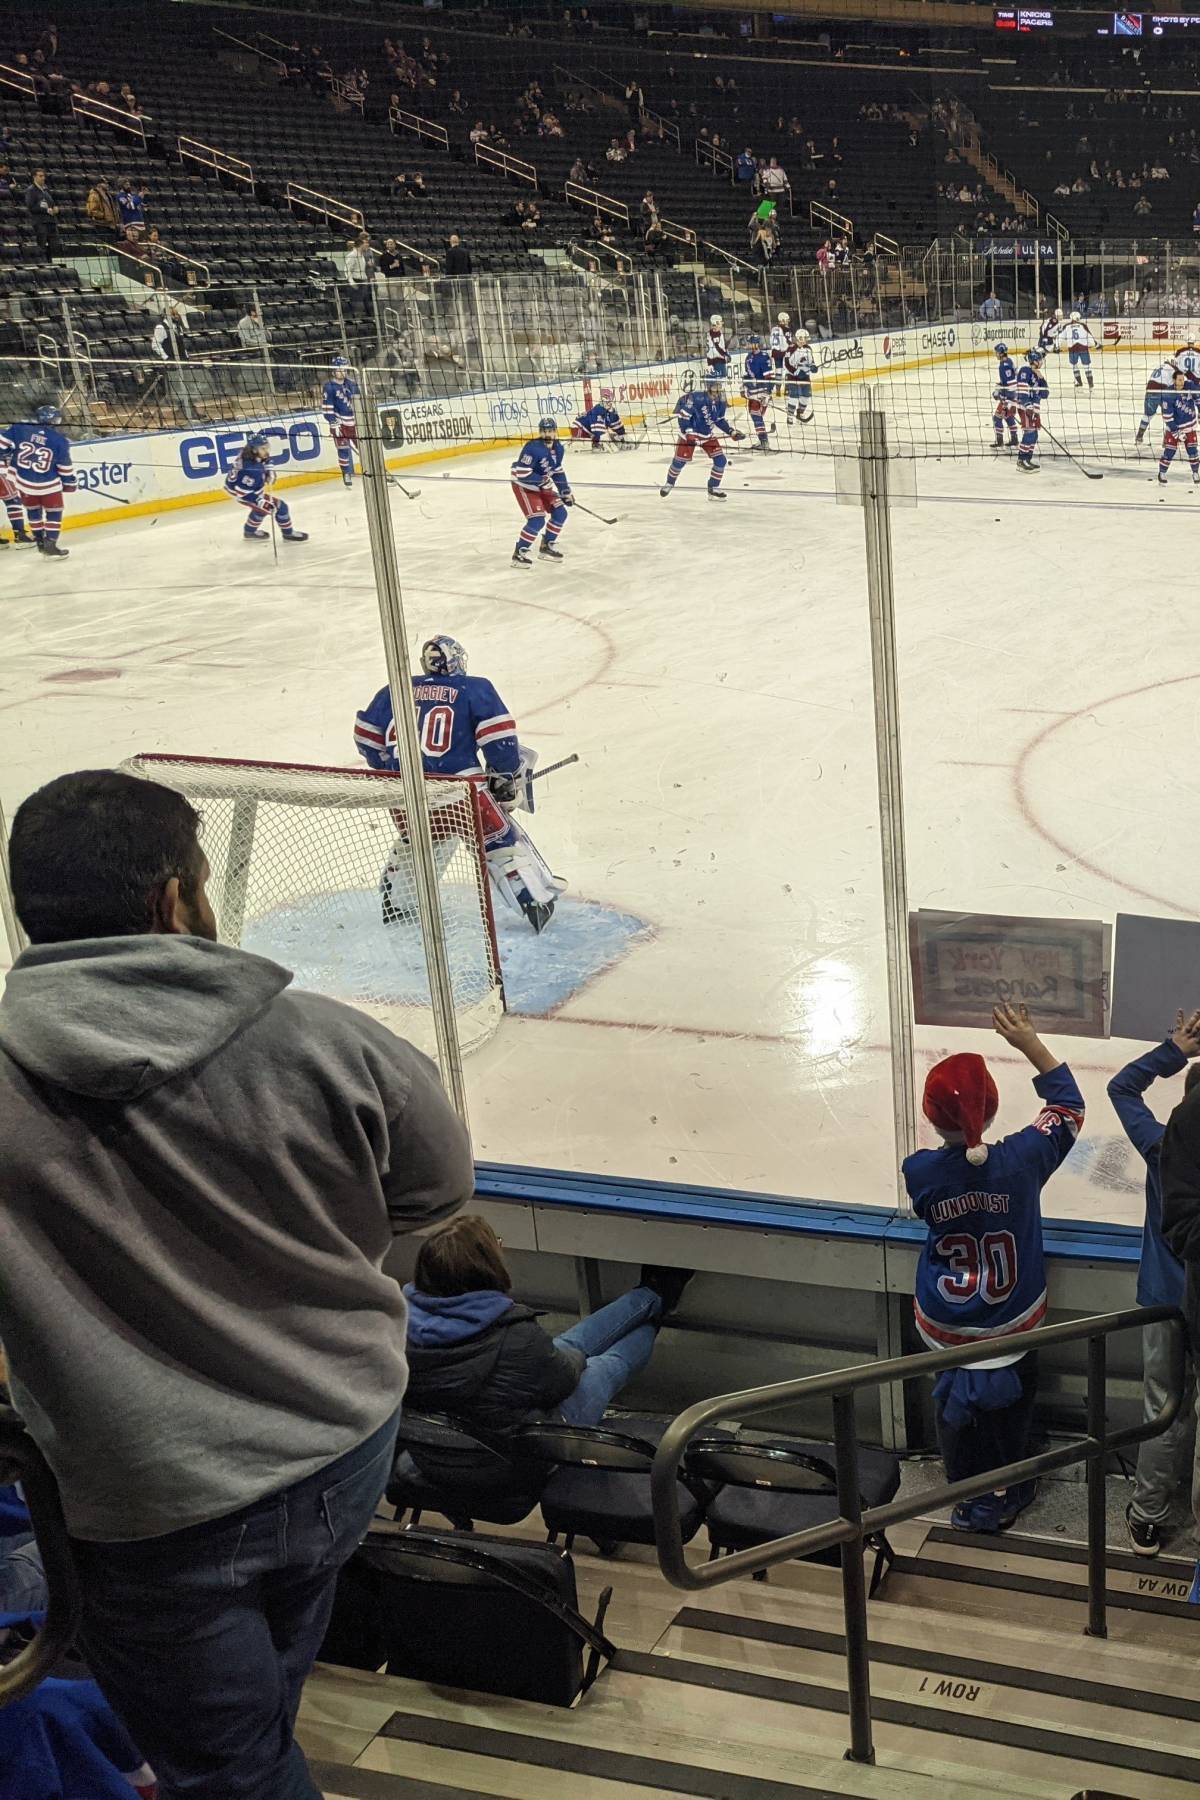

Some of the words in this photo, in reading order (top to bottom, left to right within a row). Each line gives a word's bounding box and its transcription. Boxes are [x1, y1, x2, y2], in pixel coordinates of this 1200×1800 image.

[1021, 245, 1054, 255] ULRA
[921, 330, 947, 350] CHASE
[403, 403, 444, 421] CAESARS
[404, 415, 474, 445] SPORTSBOOK
[16, 441, 54, 473] 23
[179, 422, 321, 479] GECO
[931, 1191, 1009, 1224] LUNDQVIST
[936, 1230, 1018, 1305] 30
[1137, 1577, 1158, 1592] AA
[1162, 1581, 1188, 1598] OW
[918, 1676, 928, 1692] 1
[934, 1680, 981, 1702] ROW
